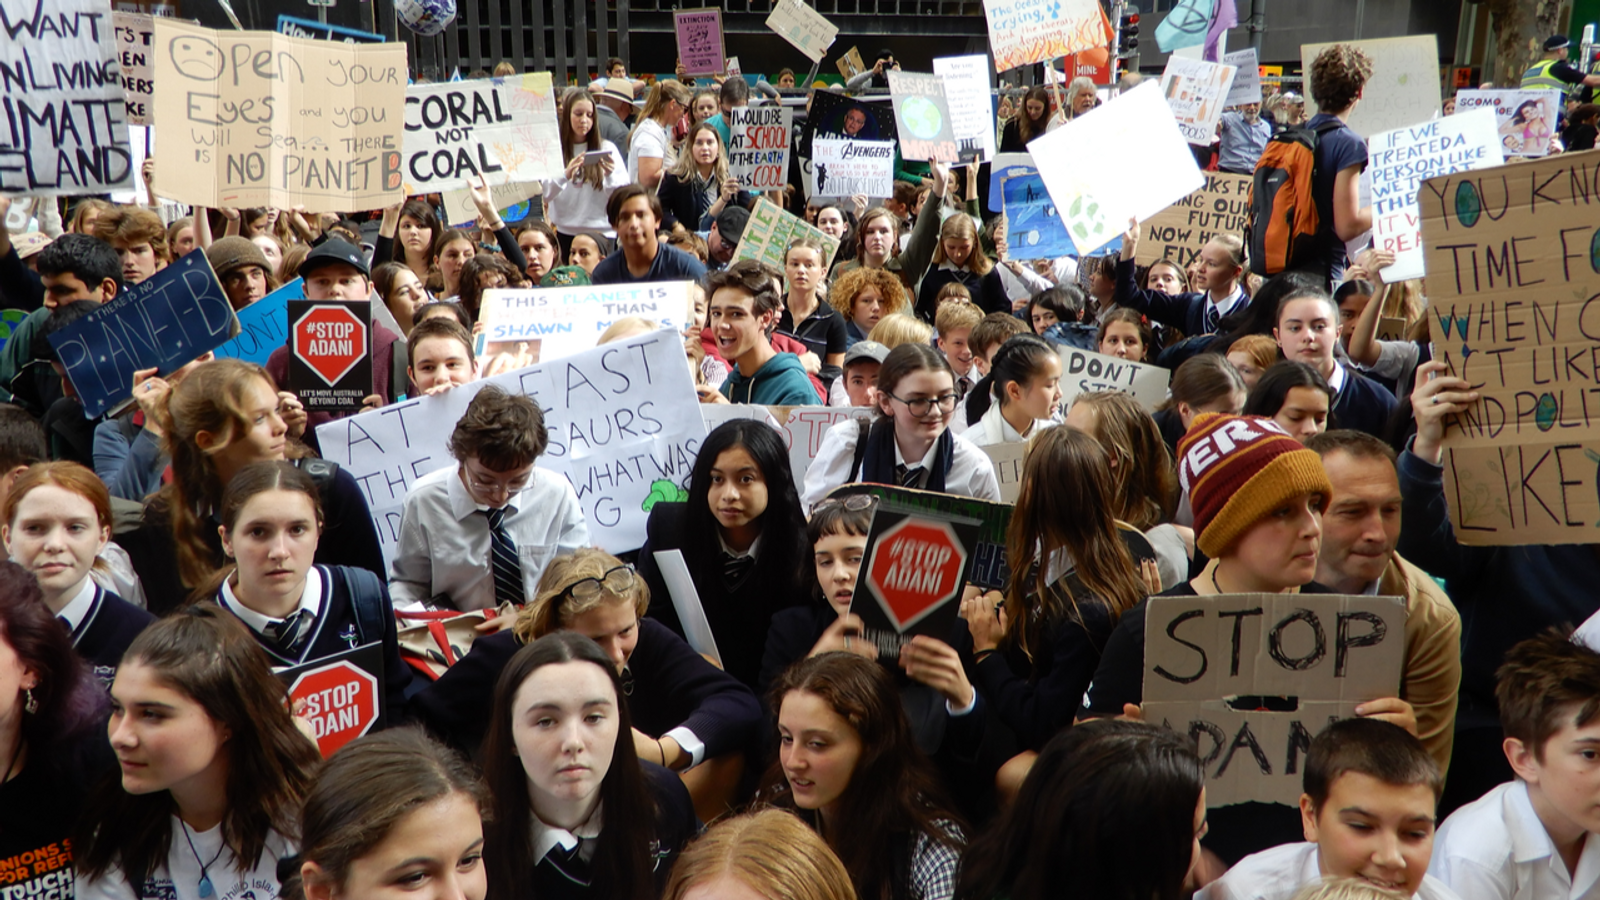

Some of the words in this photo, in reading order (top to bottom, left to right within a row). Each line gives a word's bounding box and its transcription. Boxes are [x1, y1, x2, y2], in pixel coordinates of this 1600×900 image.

[118, 51, 146, 67] EN
[168, 35, 305, 86] Open
[1077, 65, 1097, 75] MINE
[889, 73, 945, 97] RESPECT
[299, 108, 322, 117] and
[404, 89, 512, 131] CORAL
[1460, 97, 1501, 107] SCOMO
[736, 109, 770, 126] WOULD
[771, 109, 782, 125] BE
[435, 127, 473, 144] NOT
[730, 134, 745, 148] AT
[744, 126, 788, 150] SCHOOL
[1387, 130, 1405, 148] IF
[1409, 122, 1441, 141] WE
[409, 142, 502, 182] COAL
[729, 152, 737, 165] IF
[737, 152, 754, 166] THE
[755, 151, 784, 164] EARTH
[814, 145, 834, 156] THE
[841, 142, 892, 159] AVENGERS
[900, 139, 960, 162] MOTHER
[1370, 136, 1451, 168] TREATED
[1453, 133, 1466, 147] A
[227, 152, 265, 186] NO
[382, 151, 403, 192] B
[736, 172, 753, 186] AS
[753, 165, 784, 187] COOL
[1372, 156, 1443, 184] PERSON
[1449, 145, 1487, 164] LIKE
[1372, 180, 1404, 199] WE
[1427, 174, 1509, 231] YOU
[1149, 225, 1192, 242] NOW
[1378, 214, 1399, 235] IT
[1435, 236, 1546, 295] TIME
[94, 299, 127, 320] THERE
[127, 291, 138, 302] IS
[139, 281, 154, 295] NO
[502, 296, 548, 308] THIS
[563, 289, 641, 305] PLANET
[649, 288, 667, 299] IS
[603, 303, 658, 315] THAN
[306, 322, 354, 339] #STOP
[494, 322, 573, 338] SHAWN
[1434, 300, 1560, 346] WHEN
[308, 340, 353, 356] ADANI
[1069, 352, 1142, 386] DON'T
[309, 397, 336, 405] BEYOND
[337, 397, 354, 405] COAL
[348, 401, 420, 466] AT
[1449, 444, 1585, 532] LIKE
[889, 537, 952, 571] #STOP
[883, 560, 944, 596] ADANI
[1153, 607, 1388, 684] STOP
[308, 704, 360, 740] DANI
[0, 842, 60, 872] NIONS
